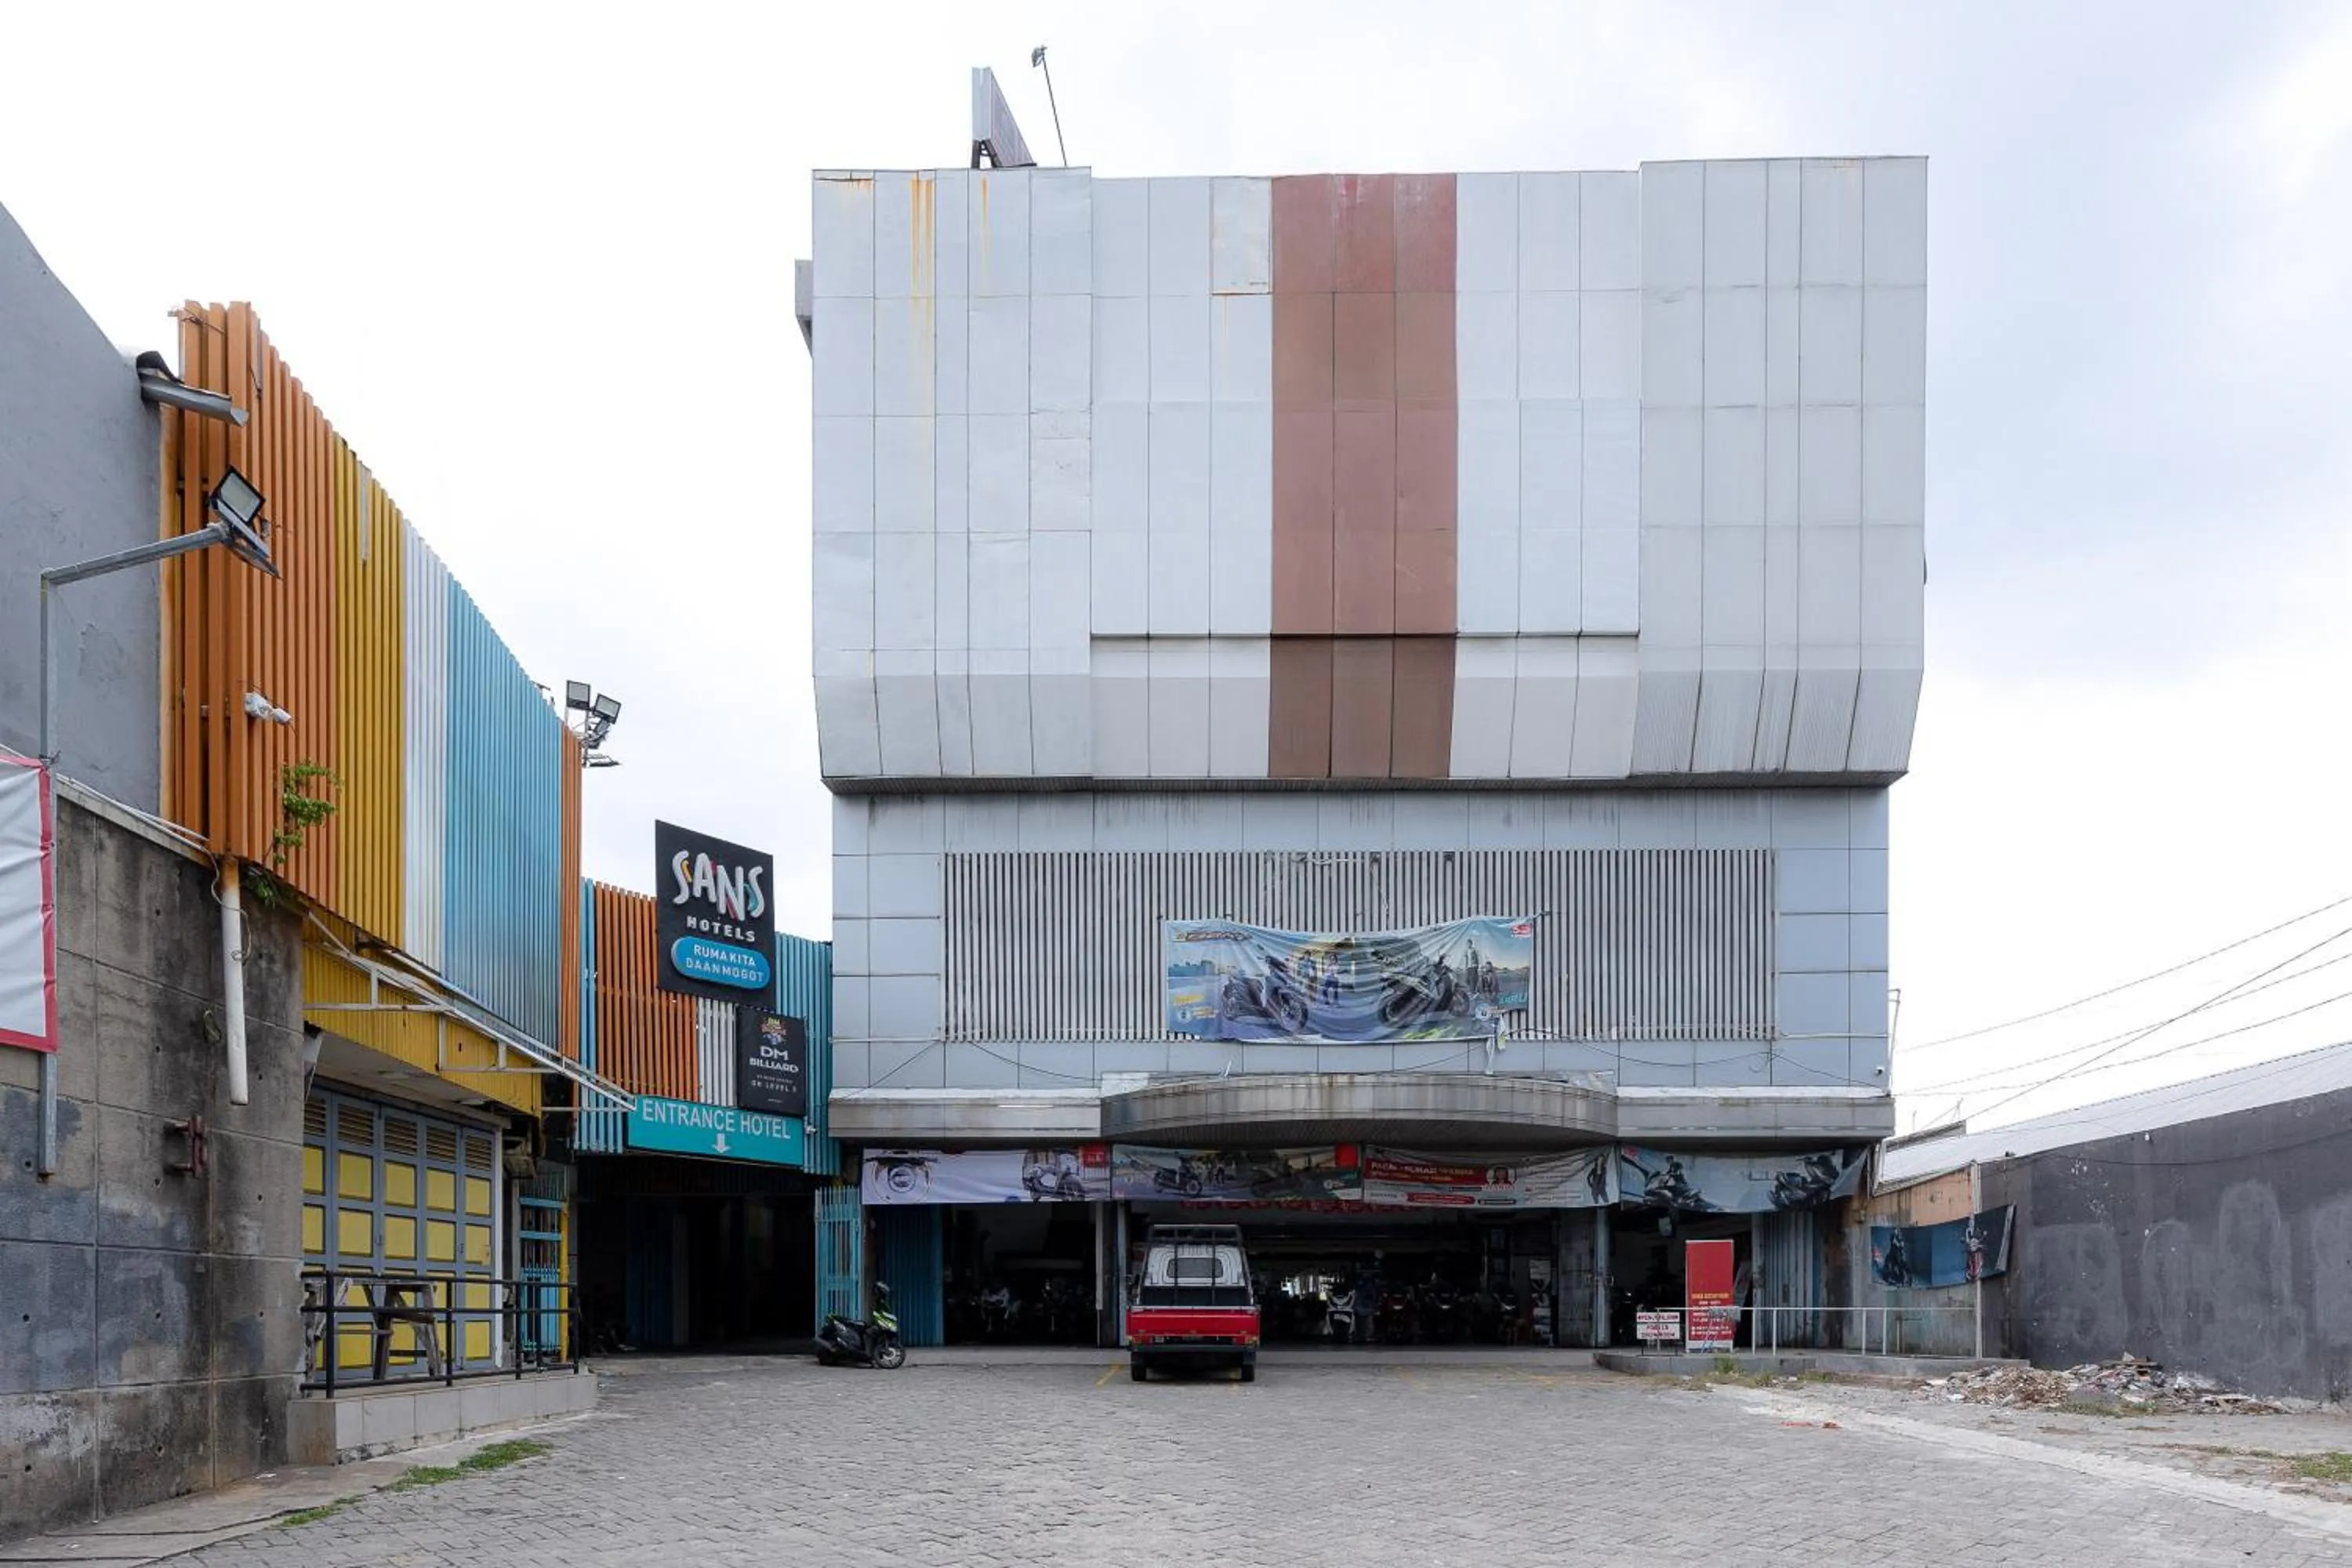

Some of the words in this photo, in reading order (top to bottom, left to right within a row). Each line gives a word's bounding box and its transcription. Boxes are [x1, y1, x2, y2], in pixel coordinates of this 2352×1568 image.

[672, 850, 765, 921] SANS
[686, 915, 756, 942] HOTELS
[686, 957, 720, 974] DAAN
[722, 966, 764, 982] MOGOT
[750, 1057, 799, 1073] BILLIARD
[760, 1045, 789, 1061] DM
[642, 1100, 735, 1131] ENTRANCE
[740, 1113, 791, 1139] HOTEL
